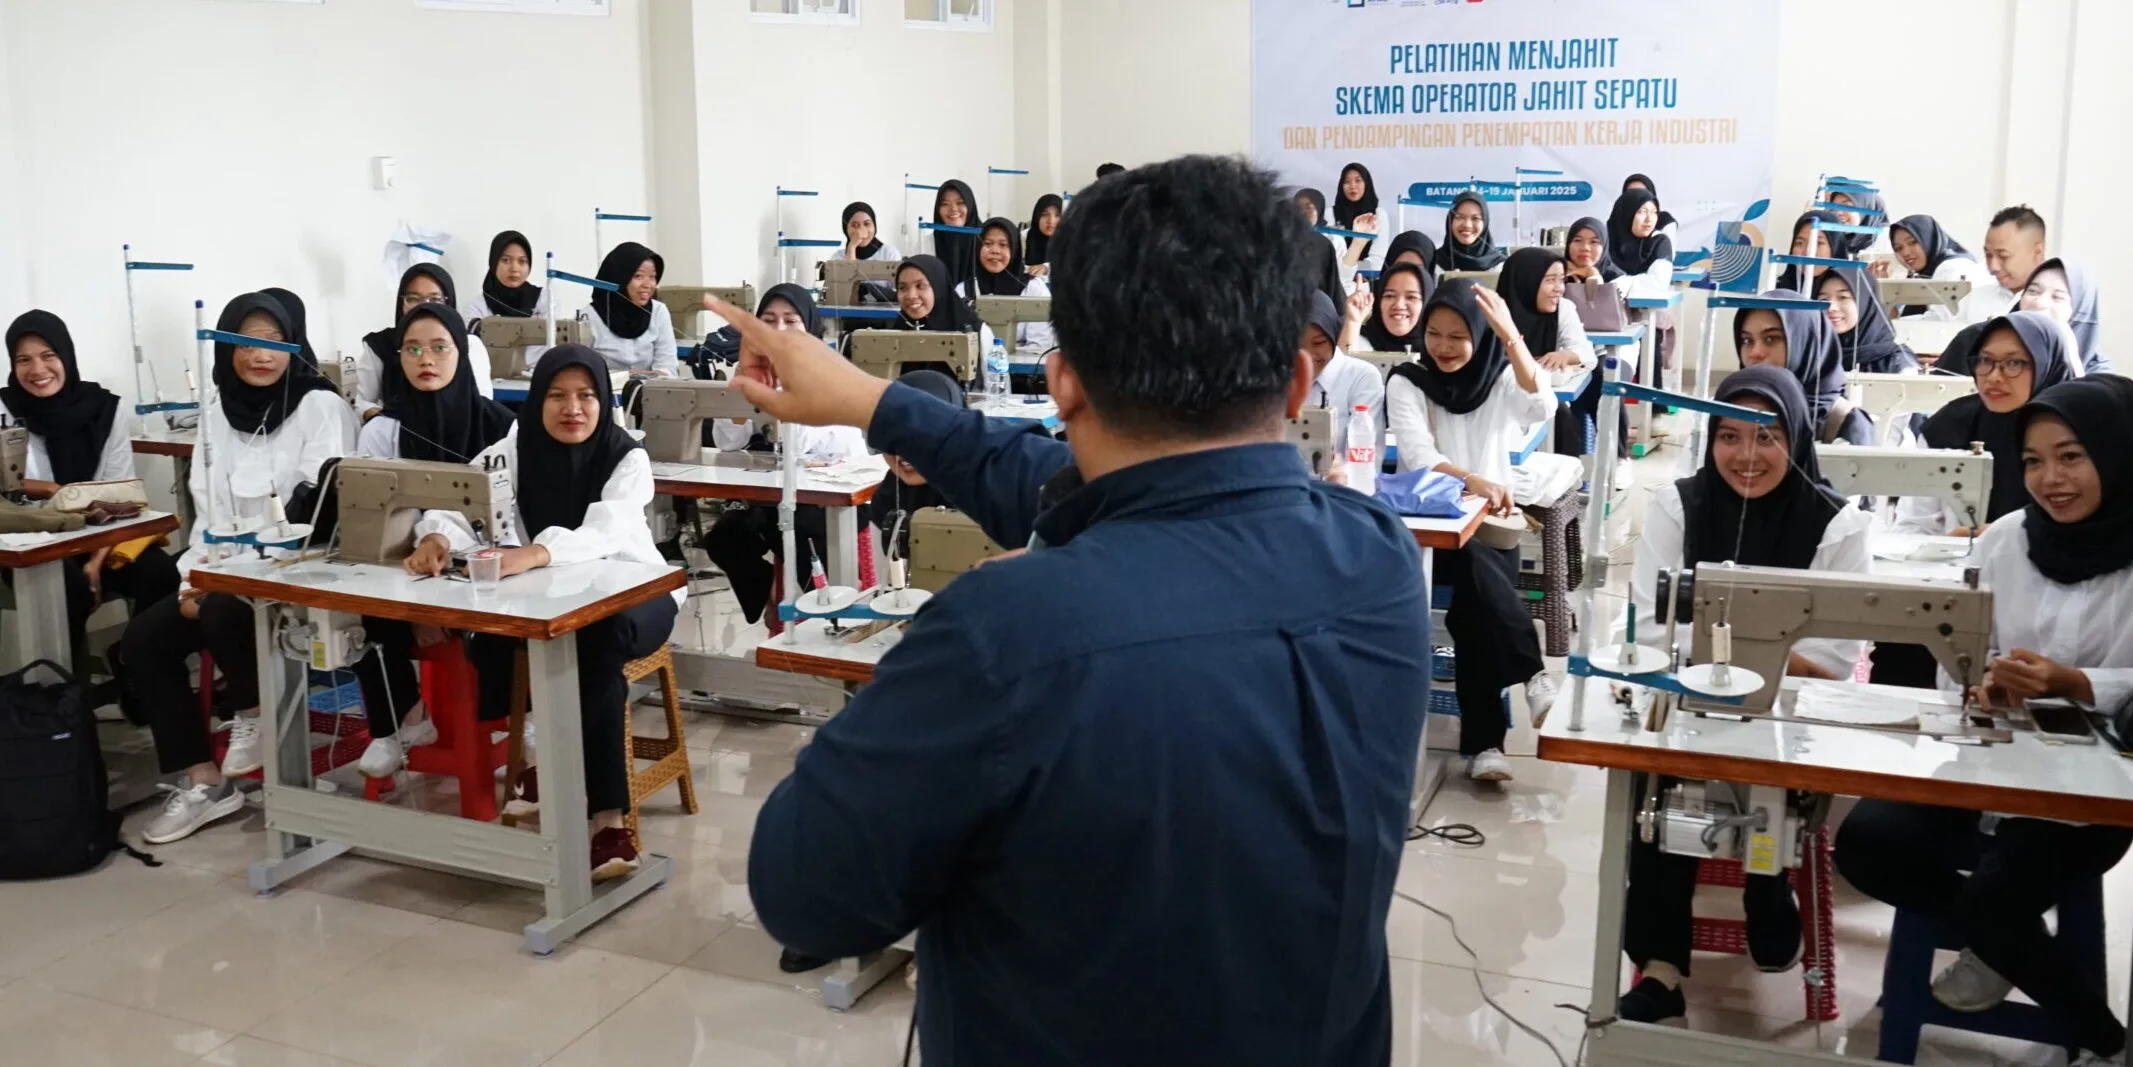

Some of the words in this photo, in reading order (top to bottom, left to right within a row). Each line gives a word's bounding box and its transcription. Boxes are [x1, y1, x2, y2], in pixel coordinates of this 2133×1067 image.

[1390, 42, 1501, 74] PELATIHAN
[1508, 38, 1619, 71] MENJAHIT
[1335, 84, 1405, 115] SKEMA
[1411, 82, 1517, 113] OPERATOR
[1523, 80, 1588, 111] JAHIT
[1594, 78, 1678, 109] SEPATU
[1283, 126, 1317, 150] DAN
[1323, 123, 1457, 149] PENDAMPINGAN
[1462, 121, 1577, 147] PENEMPATAN
[1584, 120, 1643, 145] KERJA
[1649, 118, 1738, 144] INDUSTRI
[1474, 187, 1500, 196] 4-19
[1550, 186, 1577, 195] 2025
